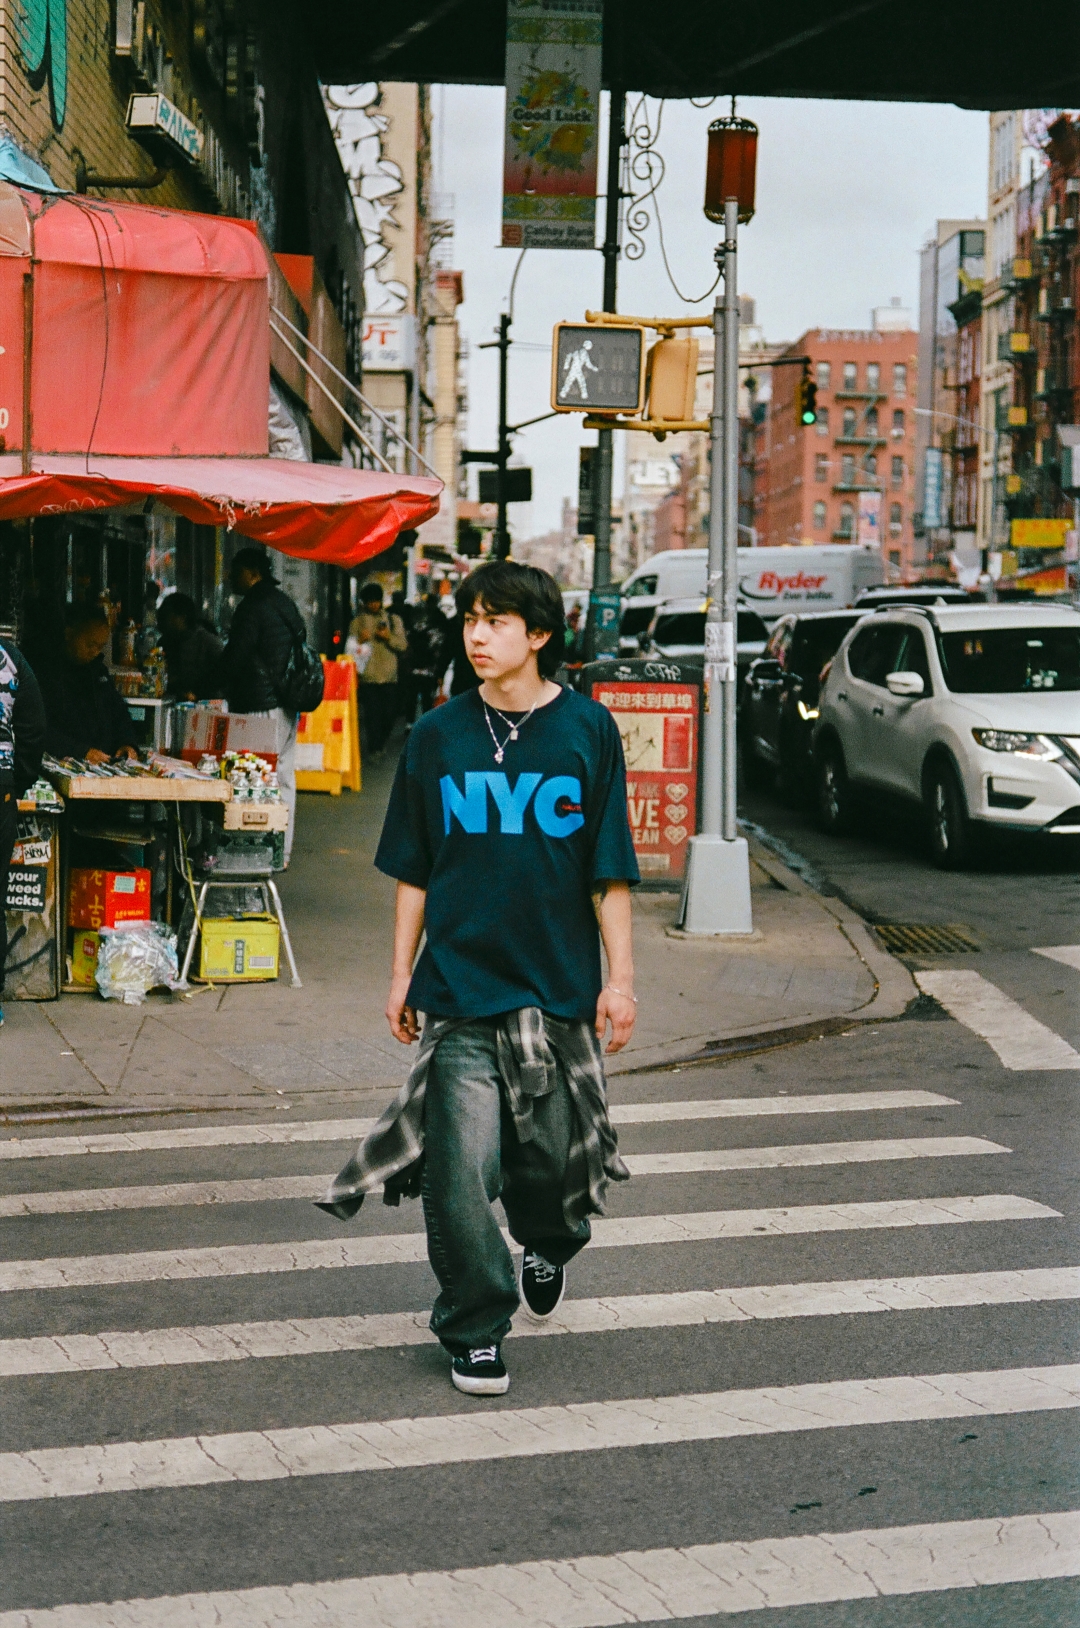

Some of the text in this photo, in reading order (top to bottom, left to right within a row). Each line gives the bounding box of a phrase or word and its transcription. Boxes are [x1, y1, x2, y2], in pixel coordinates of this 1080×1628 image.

[513, 107, 591, 121] Good Luck
[525, 225, 595, 238] Cathay Bank
[759, 570, 826, 594] Ryder
[602, 607, 616, 627] P
[440, 771, 585, 838] NYC
[628, 799, 660, 828] VE
[633, 828, 660, 845] EAN
[8, 871, 39, 883] your
[6, 894, 44, 907] ucks.
